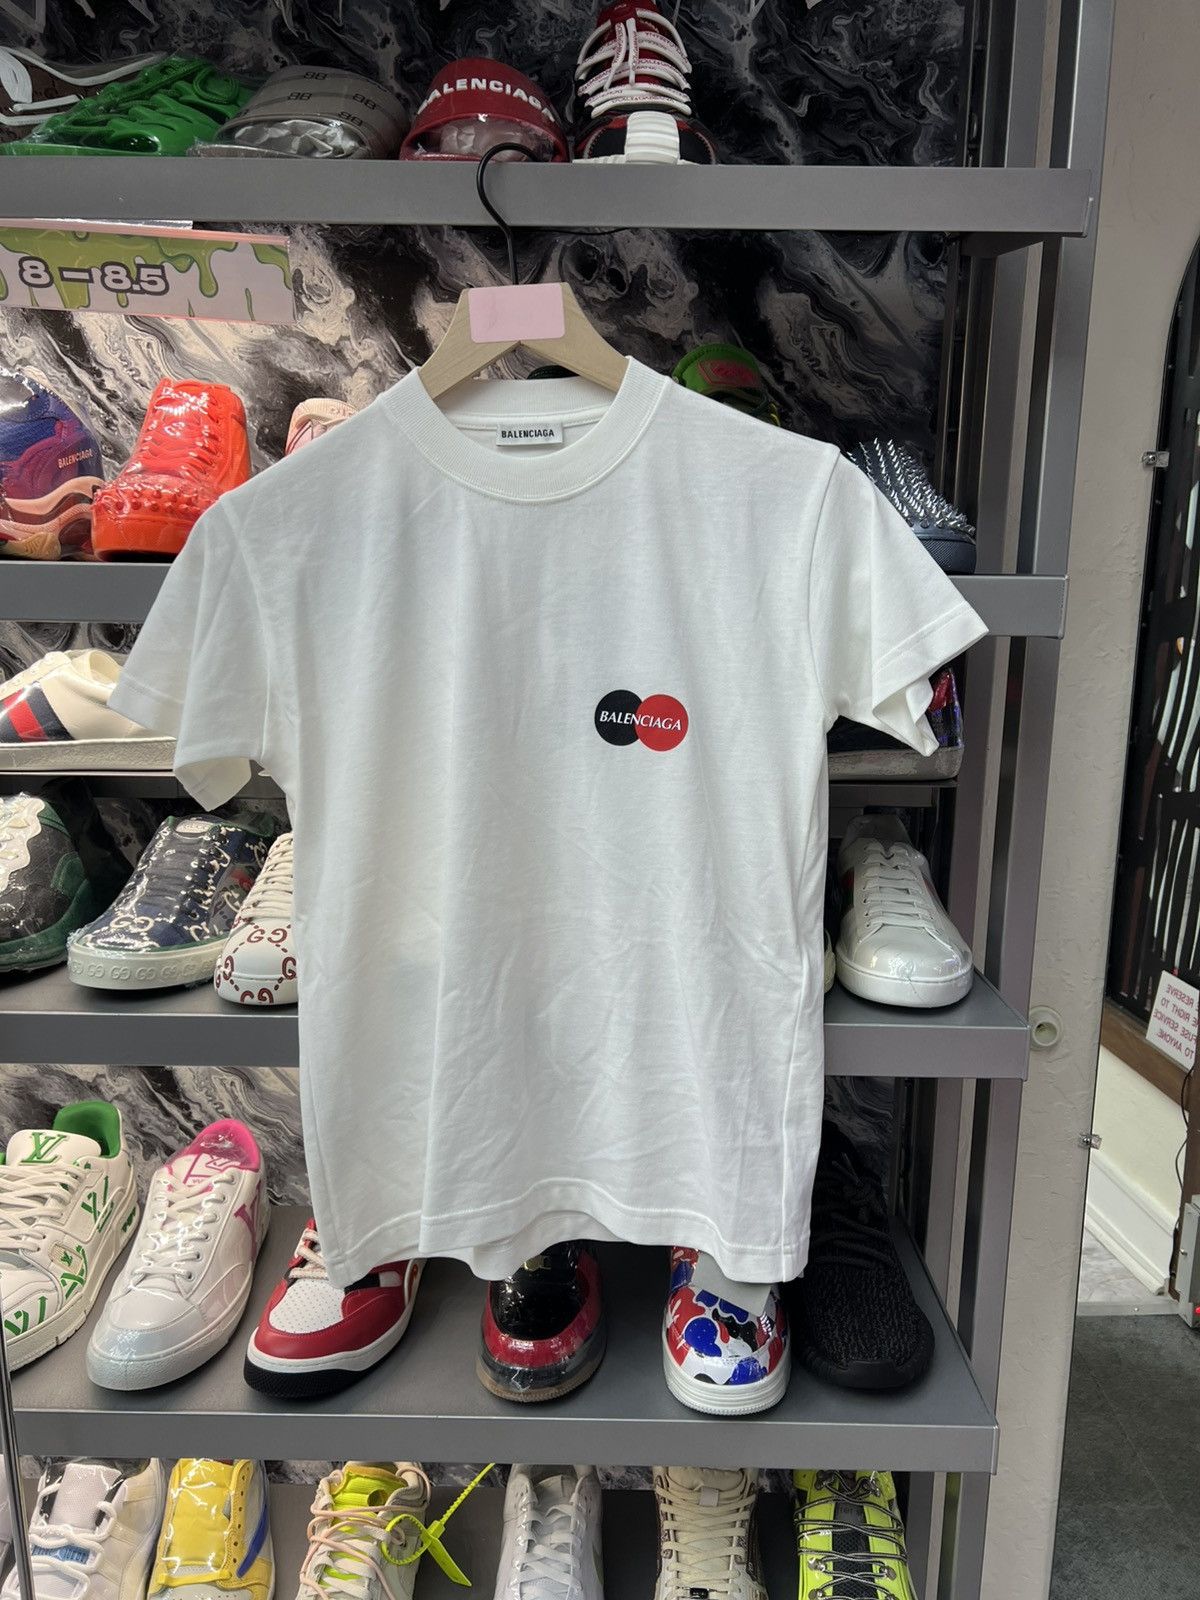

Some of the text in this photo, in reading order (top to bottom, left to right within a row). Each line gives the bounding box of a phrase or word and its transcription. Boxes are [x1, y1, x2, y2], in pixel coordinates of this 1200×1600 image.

[19, 256, 54, 288] 8
[100, 261, 170, 296] 8.5
[501, 429, 555, 438] BALENCIAGA
[599, 710, 682, 731] BALENCIAGA
